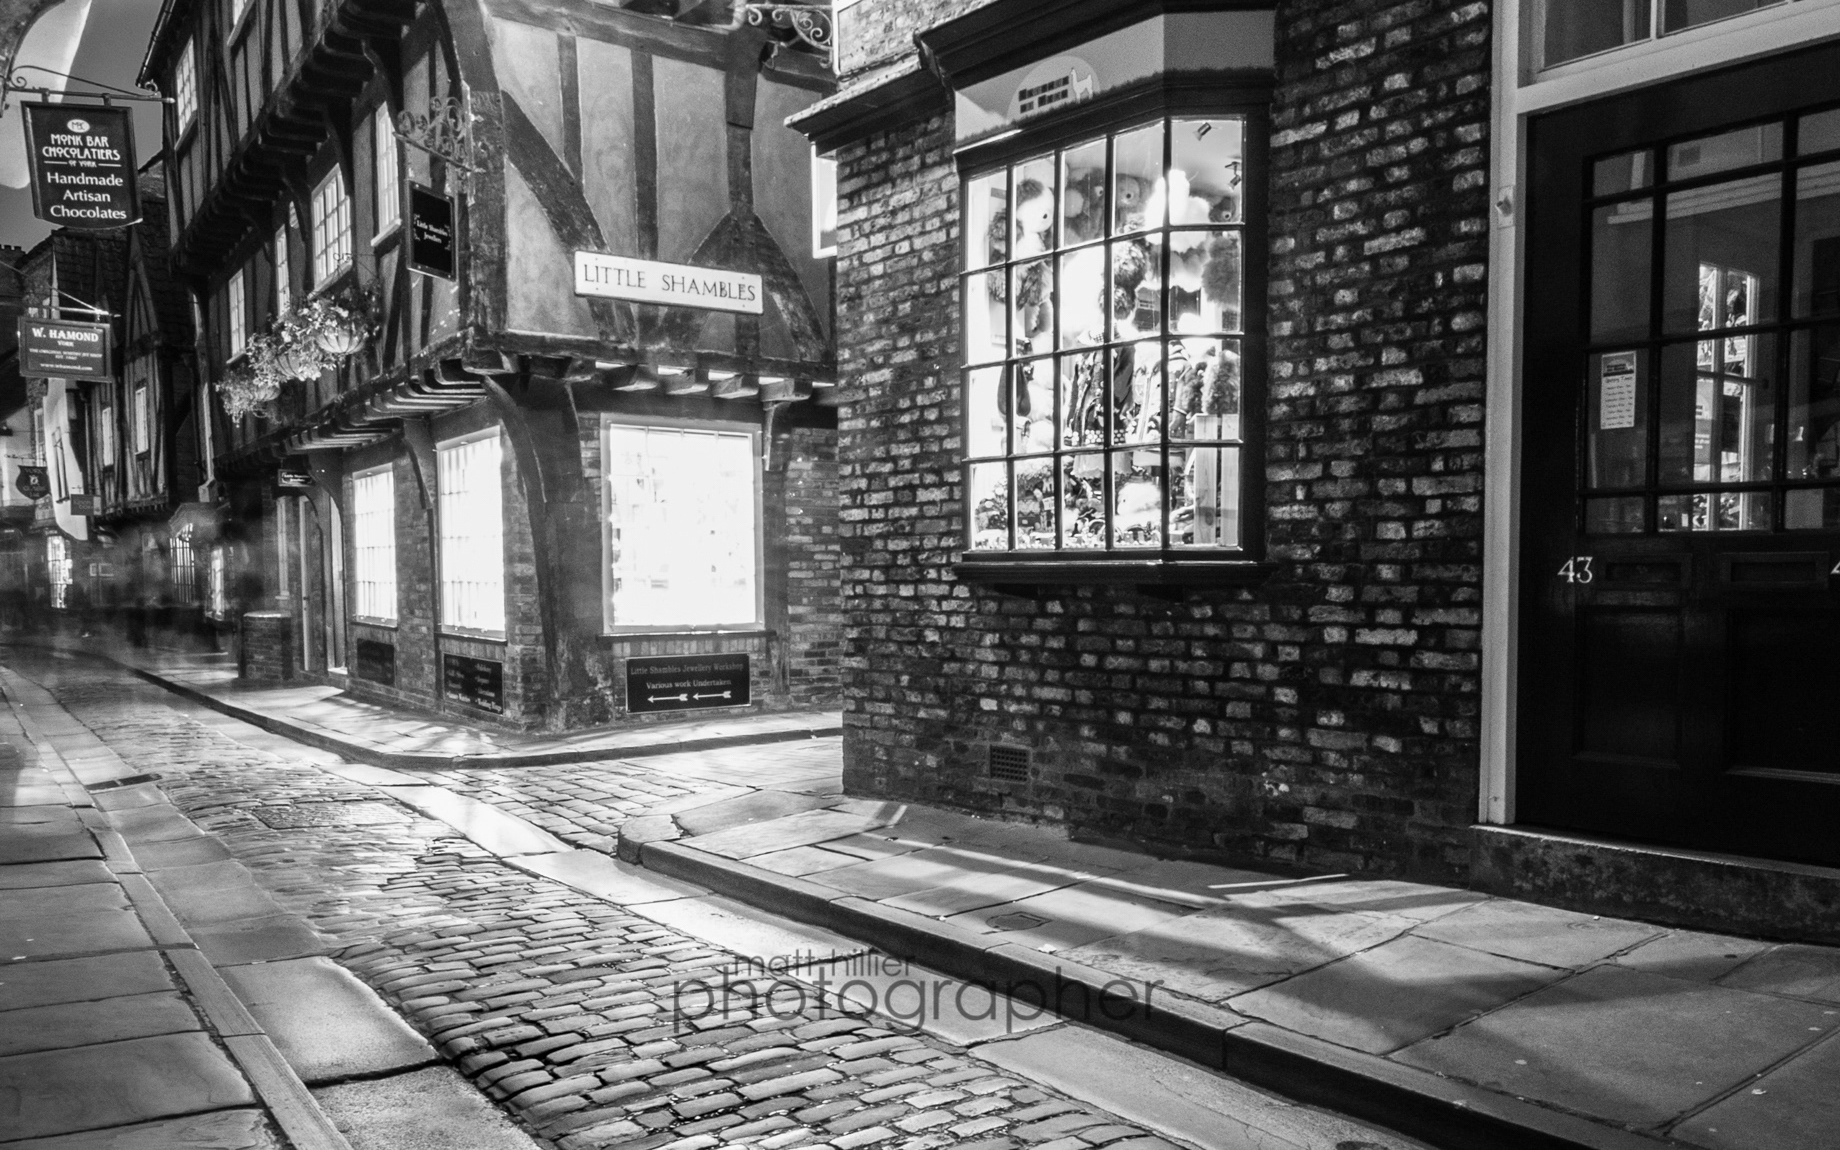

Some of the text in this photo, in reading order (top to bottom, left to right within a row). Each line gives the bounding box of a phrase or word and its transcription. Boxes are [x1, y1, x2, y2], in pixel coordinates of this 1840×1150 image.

[50, 133, 110, 148] MONK BAR
[42, 146, 121, 161] CHOCOLATIERS
[46, 172, 124, 187] Handmade
[62, 189, 111, 203] Artisan
[50, 205, 127, 219] Chocolates
[583, 263, 757, 303] LITTLE SHAMBLES
[31, 327, 99, 343] W. HAMOND
[1557, 556, 1594, 584] 43
[629, 661, 744, 676] Little Shambles Jewellery Workshop
[646, 678, 732, 690] Various work Undertaken
